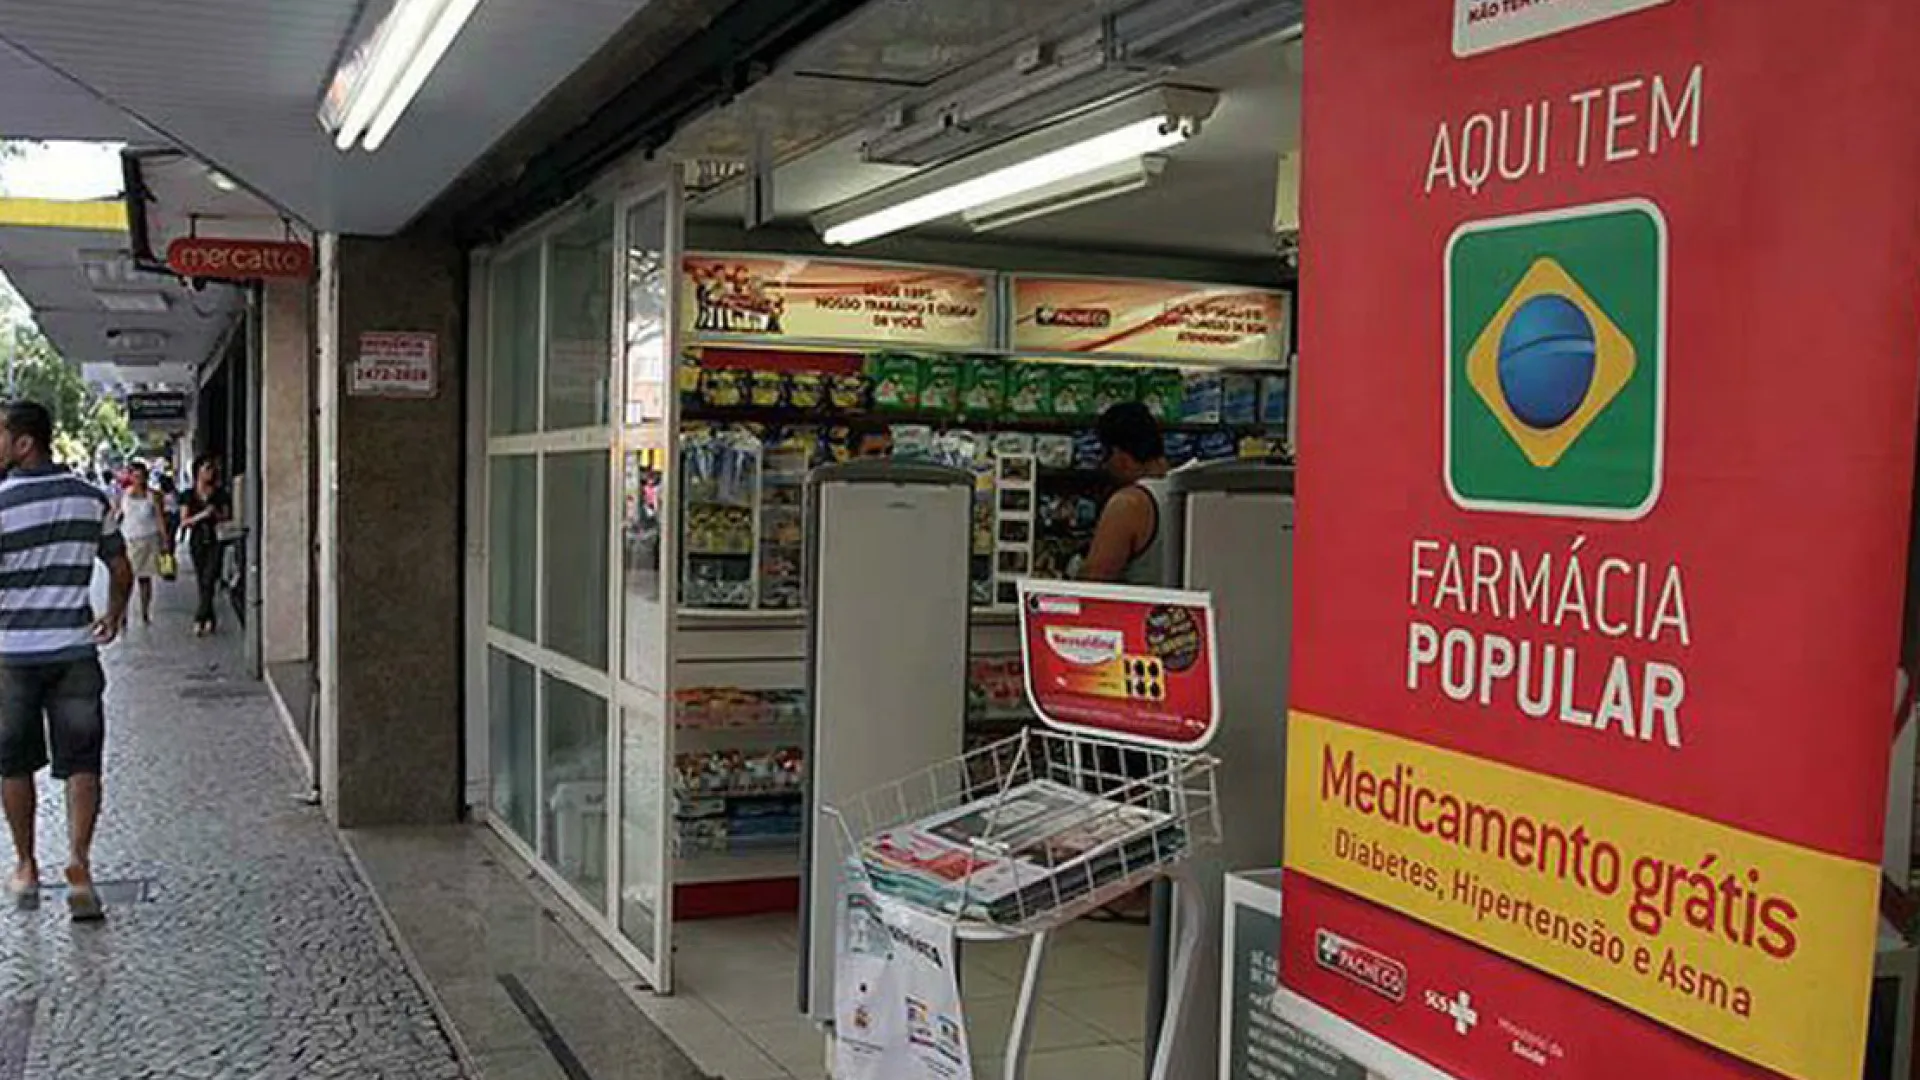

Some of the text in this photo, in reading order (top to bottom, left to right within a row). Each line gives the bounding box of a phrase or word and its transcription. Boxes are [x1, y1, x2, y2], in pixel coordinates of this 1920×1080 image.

[1424, 64, 1703, 194] AQUI TEM
[181, 246, 300, 271] mercatto
[815, 296, 862, 311] NOSSO
[1409, 535, 1691, 646] FARMÁCIA
[1406, 621, 1685, 748] POPULAR
[1320, 742, 1799, 959] Medicamento grátis
[1334, 826, 1751, 1019] Diabetes, Hipertensão e Asma
[1338, 950, 1402, 995] PACHECO
